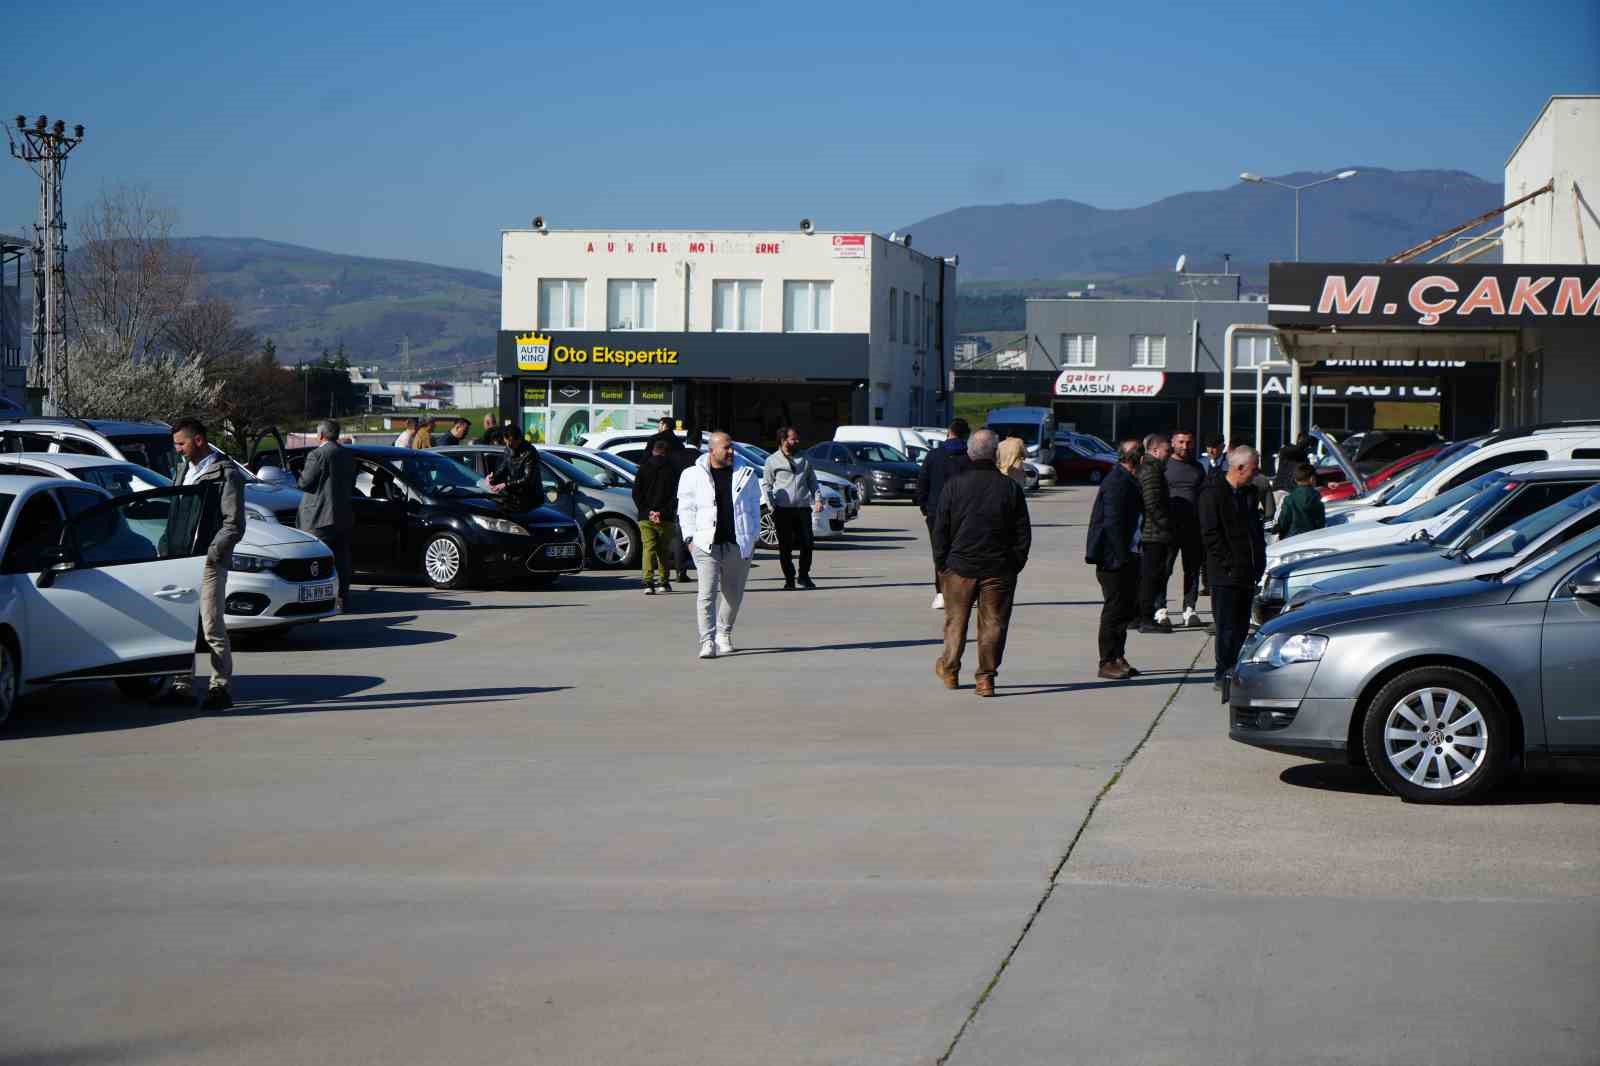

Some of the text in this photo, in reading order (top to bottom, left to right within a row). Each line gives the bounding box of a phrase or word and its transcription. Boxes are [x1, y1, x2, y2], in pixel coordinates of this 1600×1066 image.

[520, 345, 546, 354] AUTO
[521, 354, 545, 362] KING
[553, 346, 678, 367] Oto Ekspertiz
[1060, 383, 1154, 394] SAMSUN PARK
